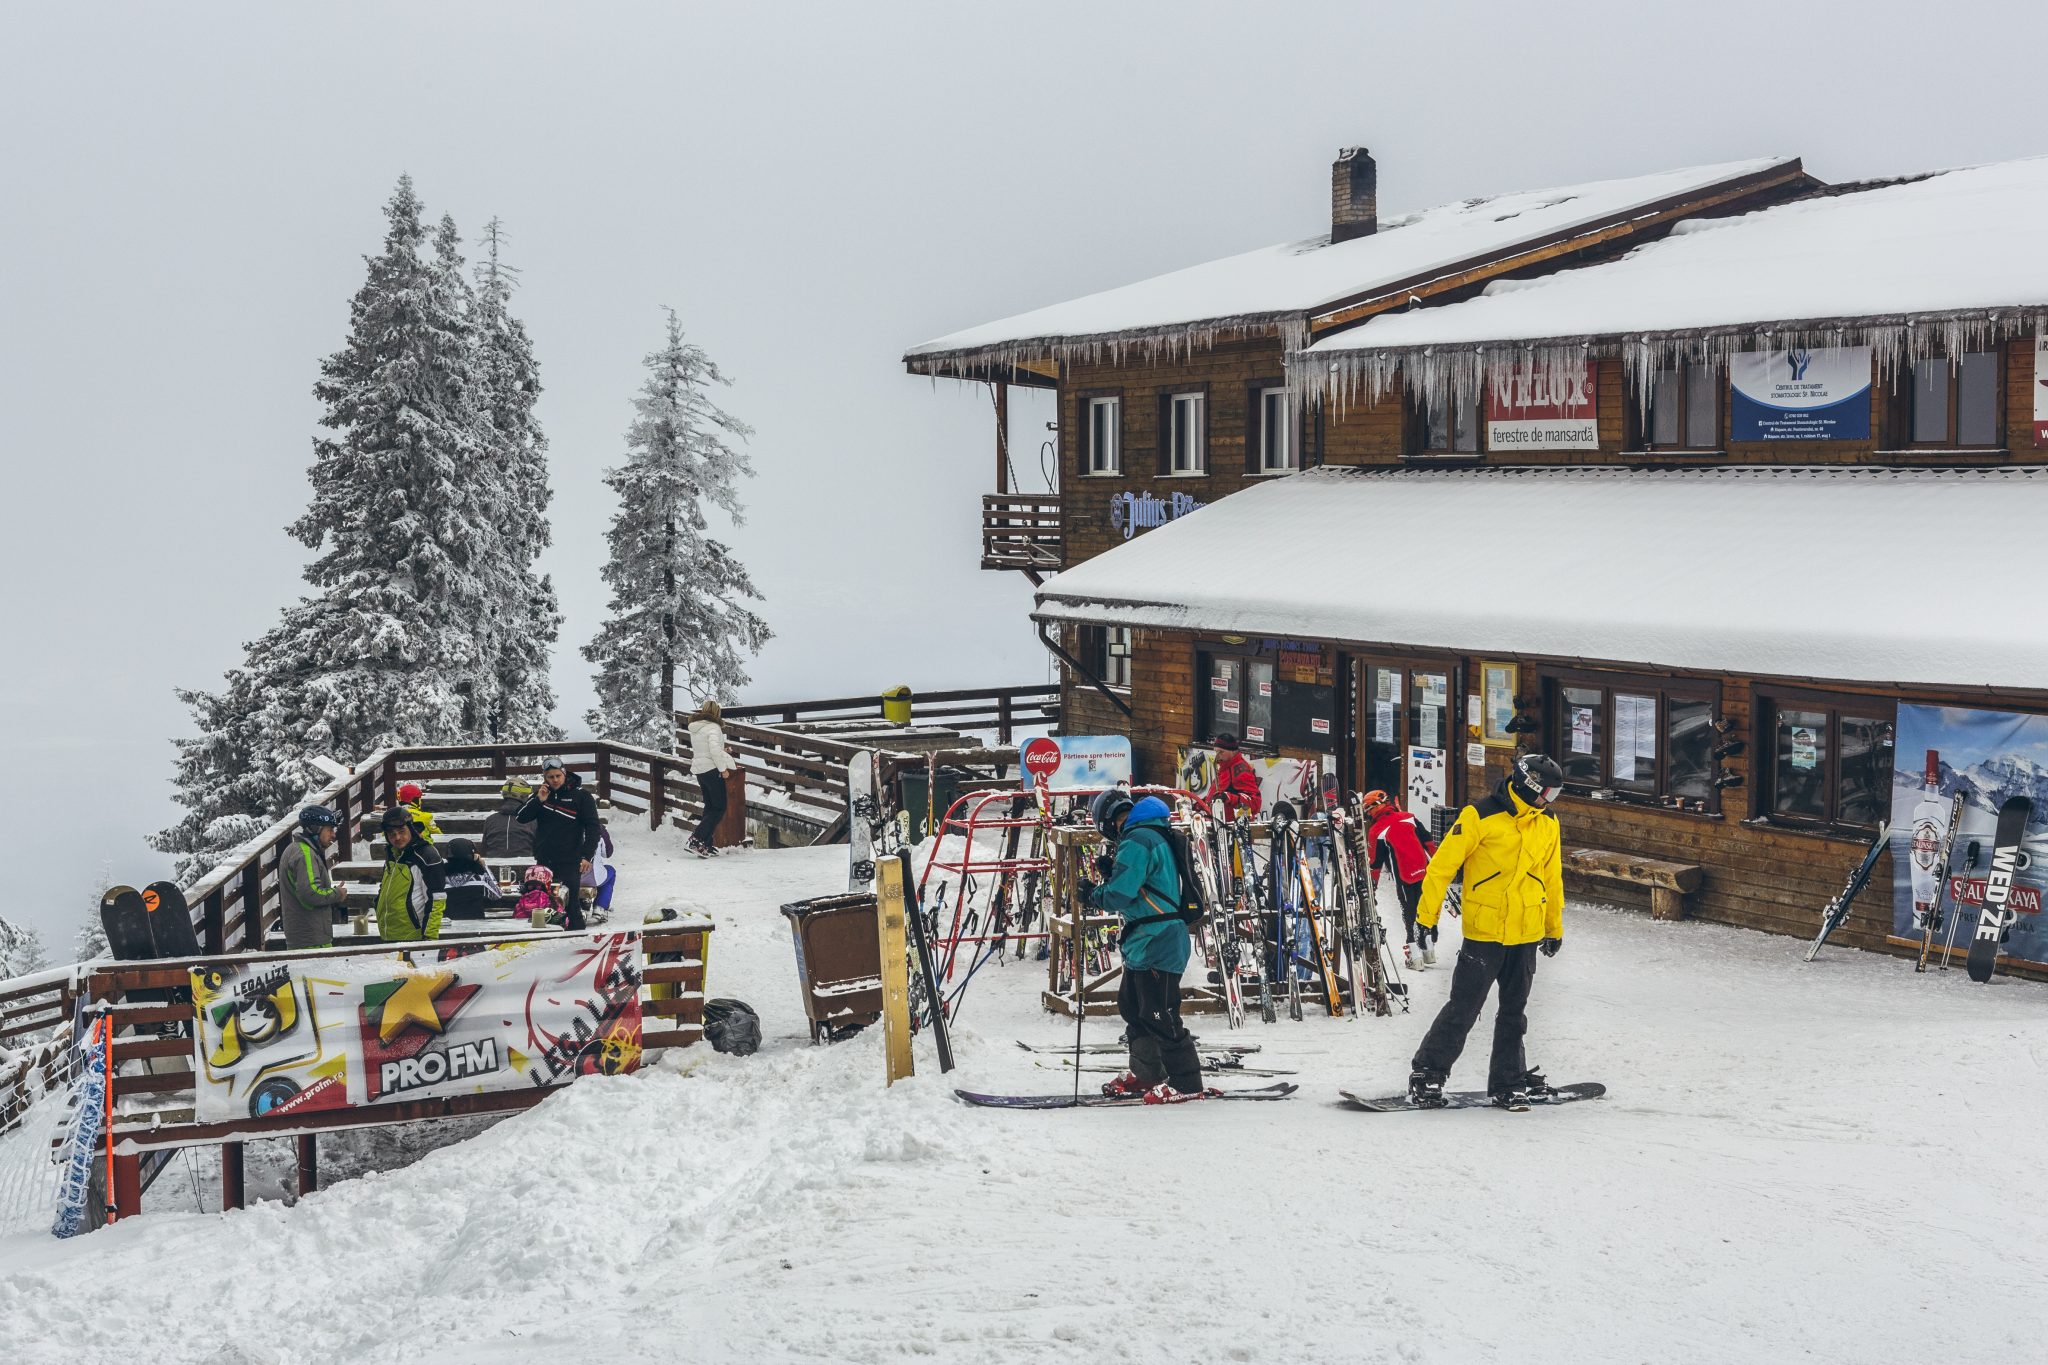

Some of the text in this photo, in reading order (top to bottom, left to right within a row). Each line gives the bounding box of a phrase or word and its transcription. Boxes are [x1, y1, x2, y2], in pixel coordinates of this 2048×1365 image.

[1493, 371, 1588, 408] VELUX
[1493, 425, 1594, 443] ferestre de mansardă
[1123, 489, 1167, 540] Julius
[1026, 751, 1059, 764] Coca-Cola
[233, 964, 290, 997] LEGALIZE
[279, 1071, 344, 1113] www.profm.ro
